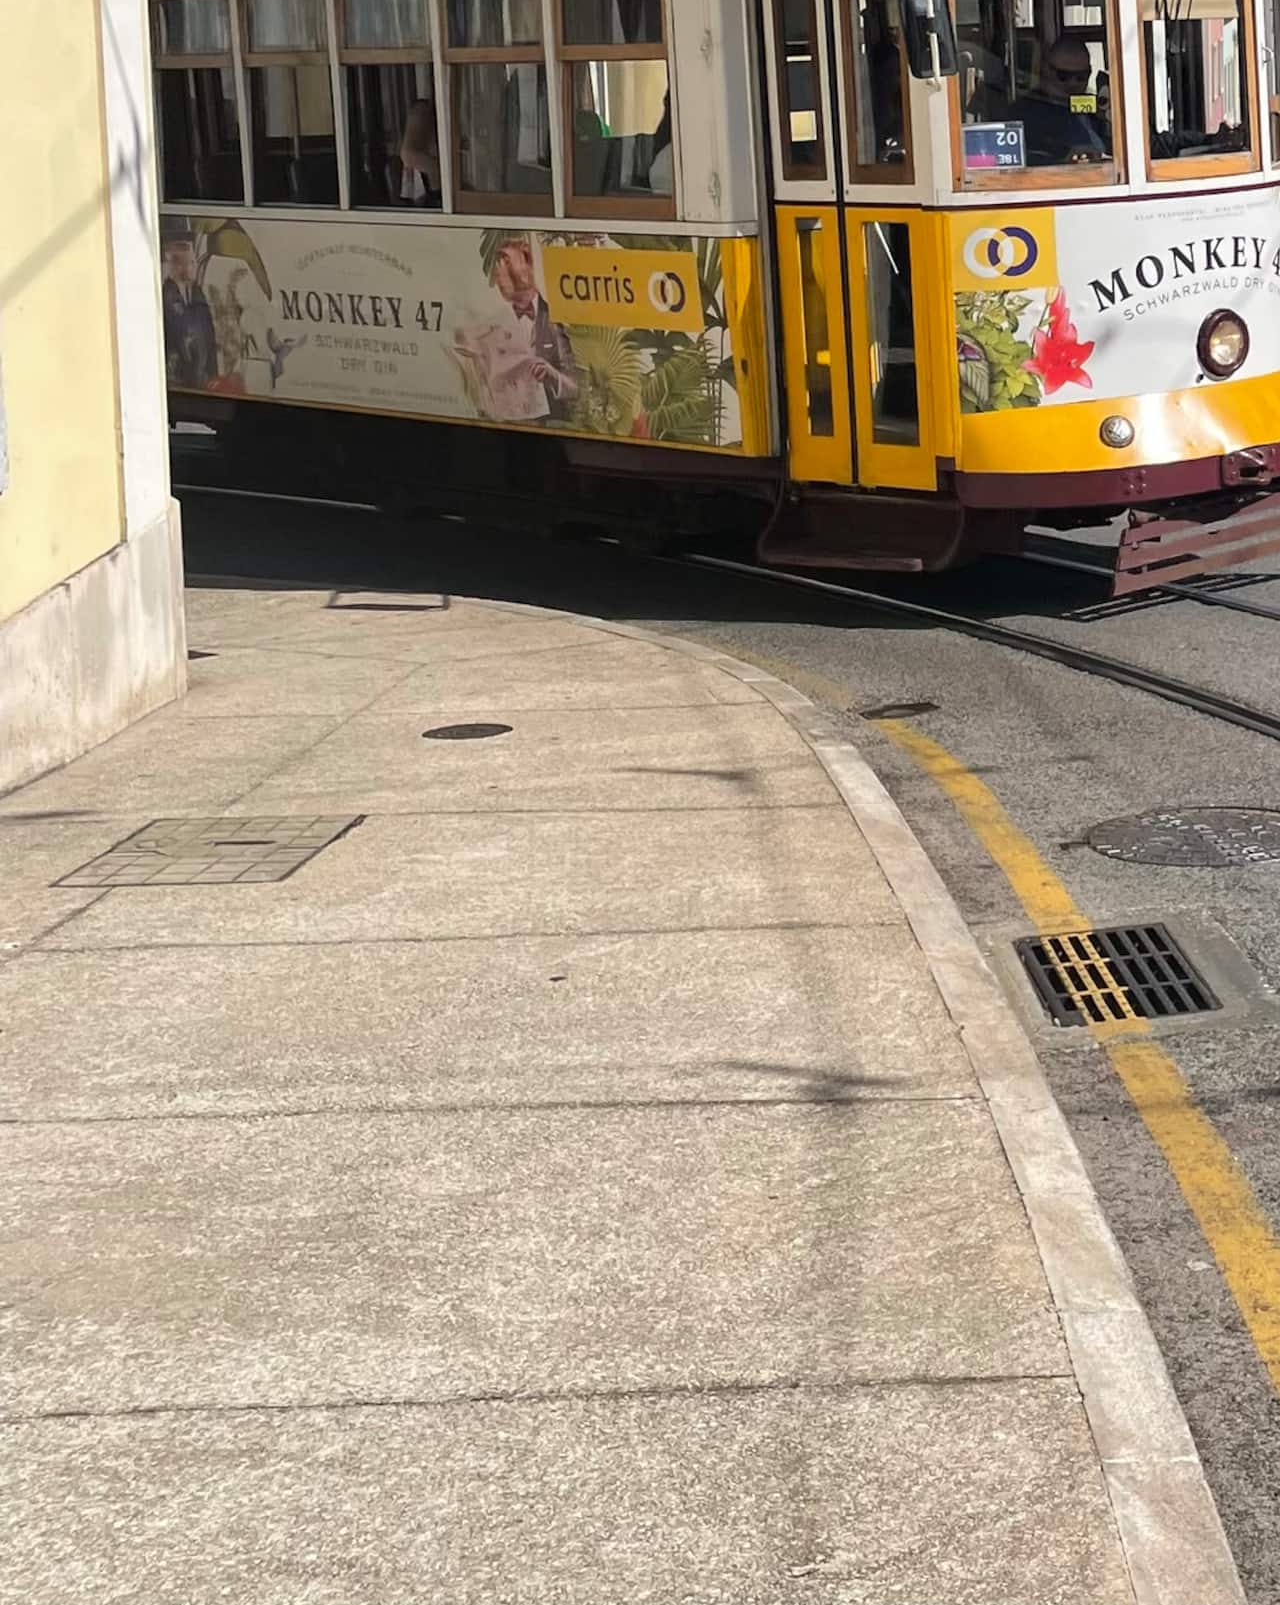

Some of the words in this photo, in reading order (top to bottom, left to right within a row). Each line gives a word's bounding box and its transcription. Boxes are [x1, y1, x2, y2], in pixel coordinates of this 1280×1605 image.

[560, 265, 635, 304] carris
[1088, 236, 1267, 313] MONKEY
[279, 289, 404, 329] MONKEY
[415, 299, 444, 332] 47
[1123, 276, 1239, 321] SCHWARZWALD
[1244, 276, 1265, 290] DRY
